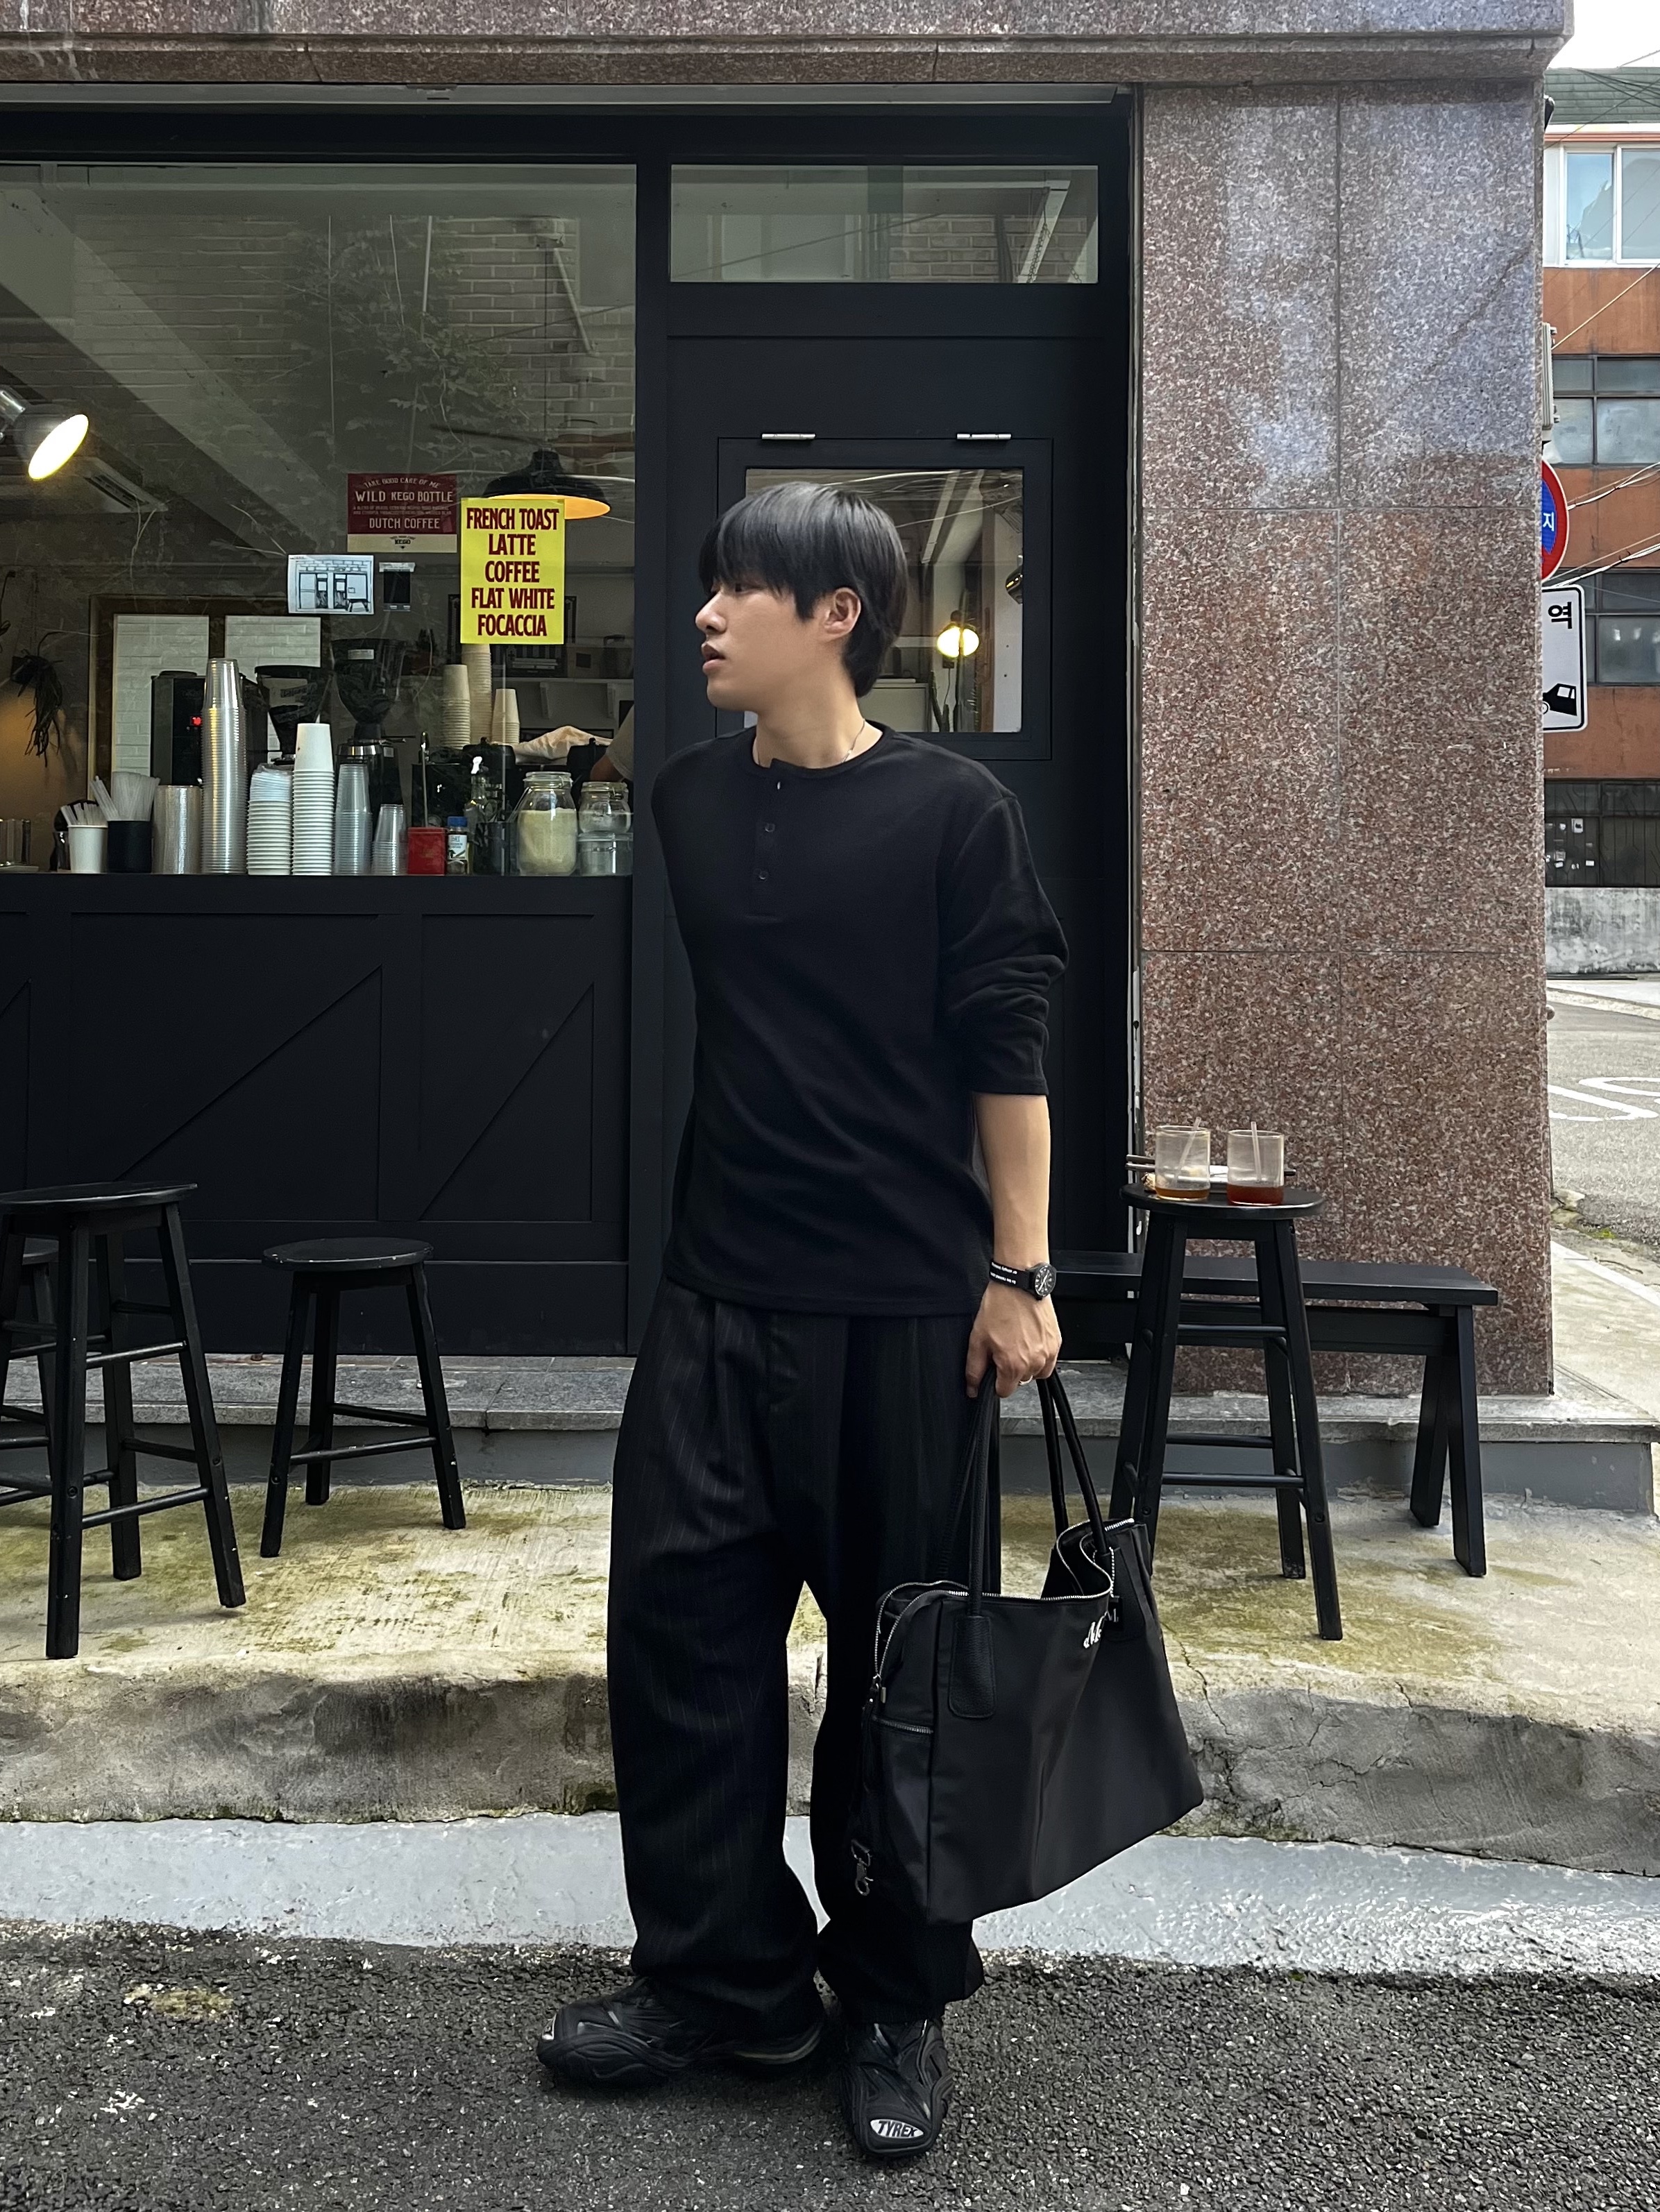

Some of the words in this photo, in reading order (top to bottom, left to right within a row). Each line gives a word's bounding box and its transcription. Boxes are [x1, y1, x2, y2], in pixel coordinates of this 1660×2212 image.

[363, 479, 381, 488] TAKE
[355, 491, 386, 502] WILD
[391, 491, 415, 501] KEGO
[417, 491, 454, 502] BOTTLE
[369, 518, 400, 529] DUTCH
[404, 518, 441, 529] COFFEE
[466, 507, 515, 529] FRENCH
[518, 508, 559, 530] TOAST
[489, 534, 536, 555] LATTE
[485, 561, 540, 583] COFFEE
[471, 588, 505, 609] FLAT
[508, 588, 555, 609] WHITE
[477, 614, 548, 636] FOCACCIA
[878, 2120, 917, 2138] TYREX
